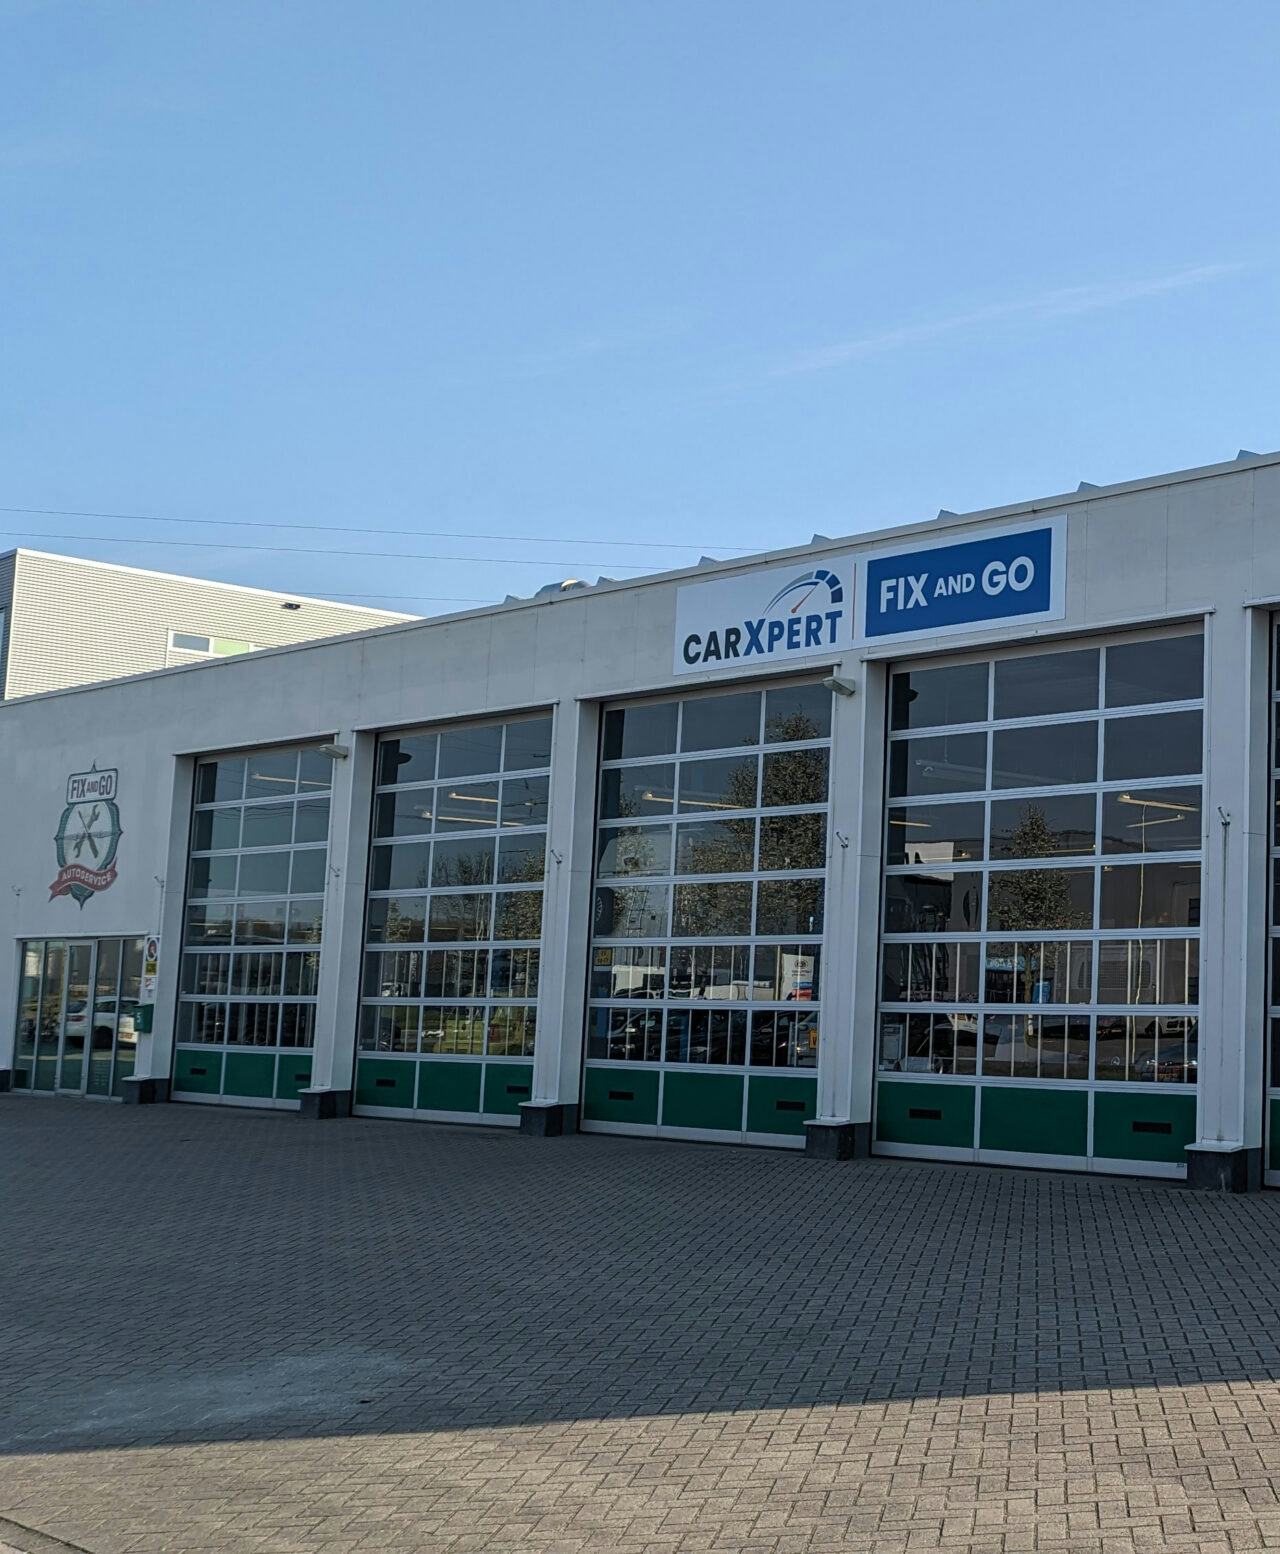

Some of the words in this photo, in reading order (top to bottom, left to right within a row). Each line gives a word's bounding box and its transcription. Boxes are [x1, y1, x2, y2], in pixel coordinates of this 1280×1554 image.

[880, 572, 929, 613] FIX
[933, 572, 975, 599] AND
[981, 556, 1035, 596] GO
[683, 610, 843, 665] CARXPERT
[70, 778, 86, 799] FIX
[86, 780, 98, 794] AND
[98, 775, 112, 796] GO
[62, 868, 112, 886] AUTOSERVICE
